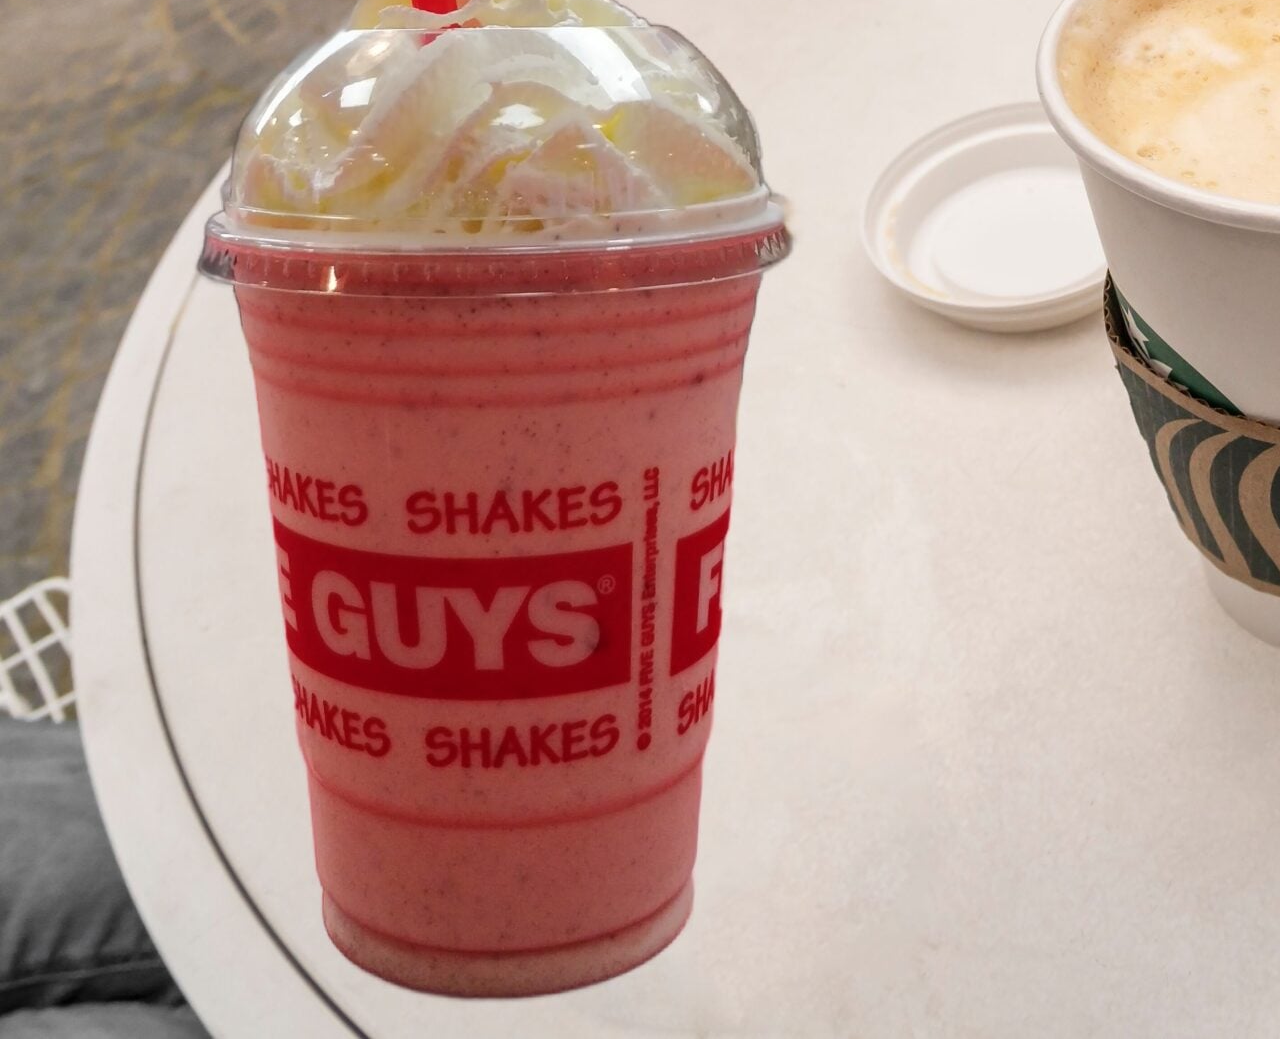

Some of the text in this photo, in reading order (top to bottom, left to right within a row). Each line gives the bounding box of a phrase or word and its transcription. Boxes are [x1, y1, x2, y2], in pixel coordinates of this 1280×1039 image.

[405, 481, 623, 535] SHAKES
[643, 466, 660, 501] LLC
[311, 569, 600, 672] GUYS
[641, 603, 657, 647] GUYS
[639, 648, 654, 686] FIVE
[424, 714, 621, 769] SHAKES
